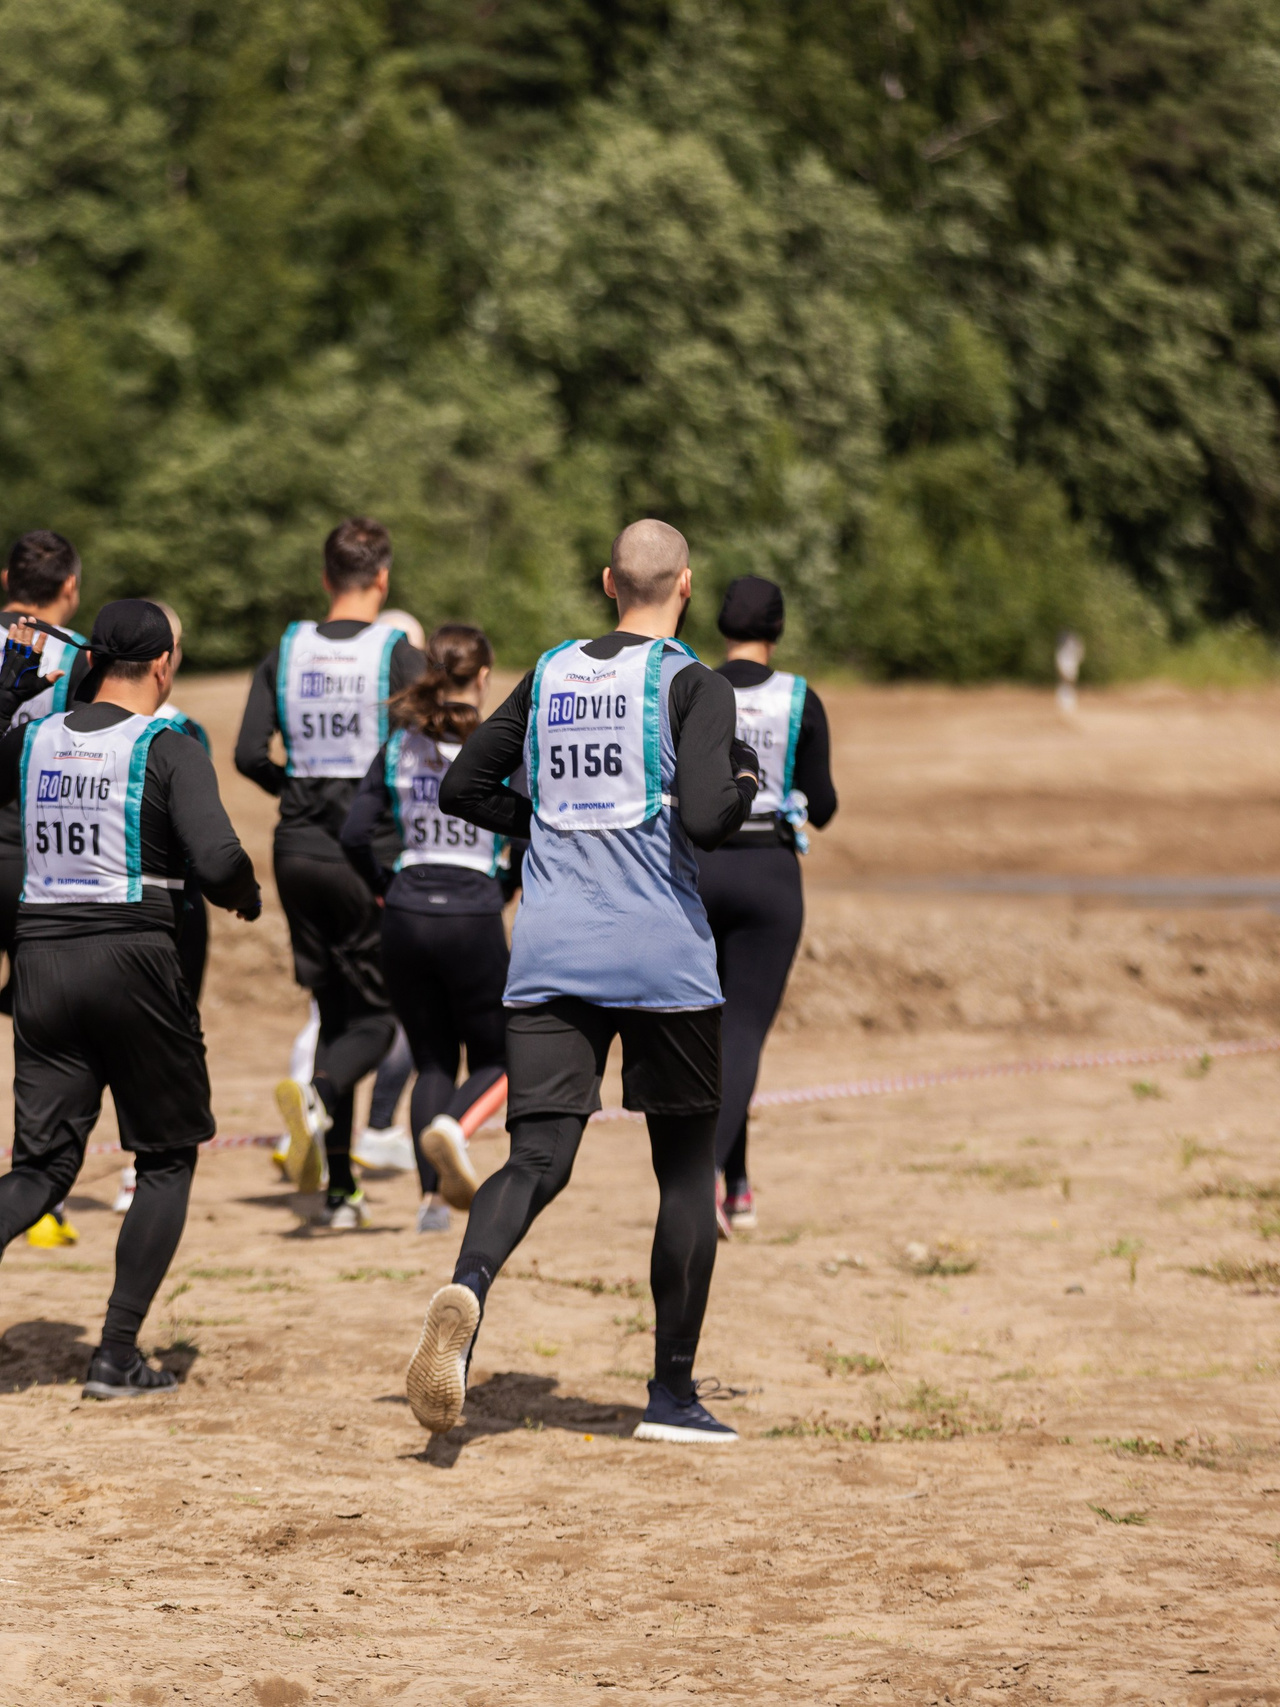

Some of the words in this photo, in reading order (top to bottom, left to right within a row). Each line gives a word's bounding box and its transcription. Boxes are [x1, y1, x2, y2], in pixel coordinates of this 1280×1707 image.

[549, 693, 627, 723] RODVIG
[302, 713, 361, 739] 5164
[550, 742, 623, 780] 5156
[38, 774, 111, 801] RODVIG
[571, 802, 616, 811] ГАЗПРОМБАНК
[36, 820, 101, 856] 5161
[413, 818, 478, 846] 5159
[56, 877, 100, 886] ГАЗПРОМБАНК
